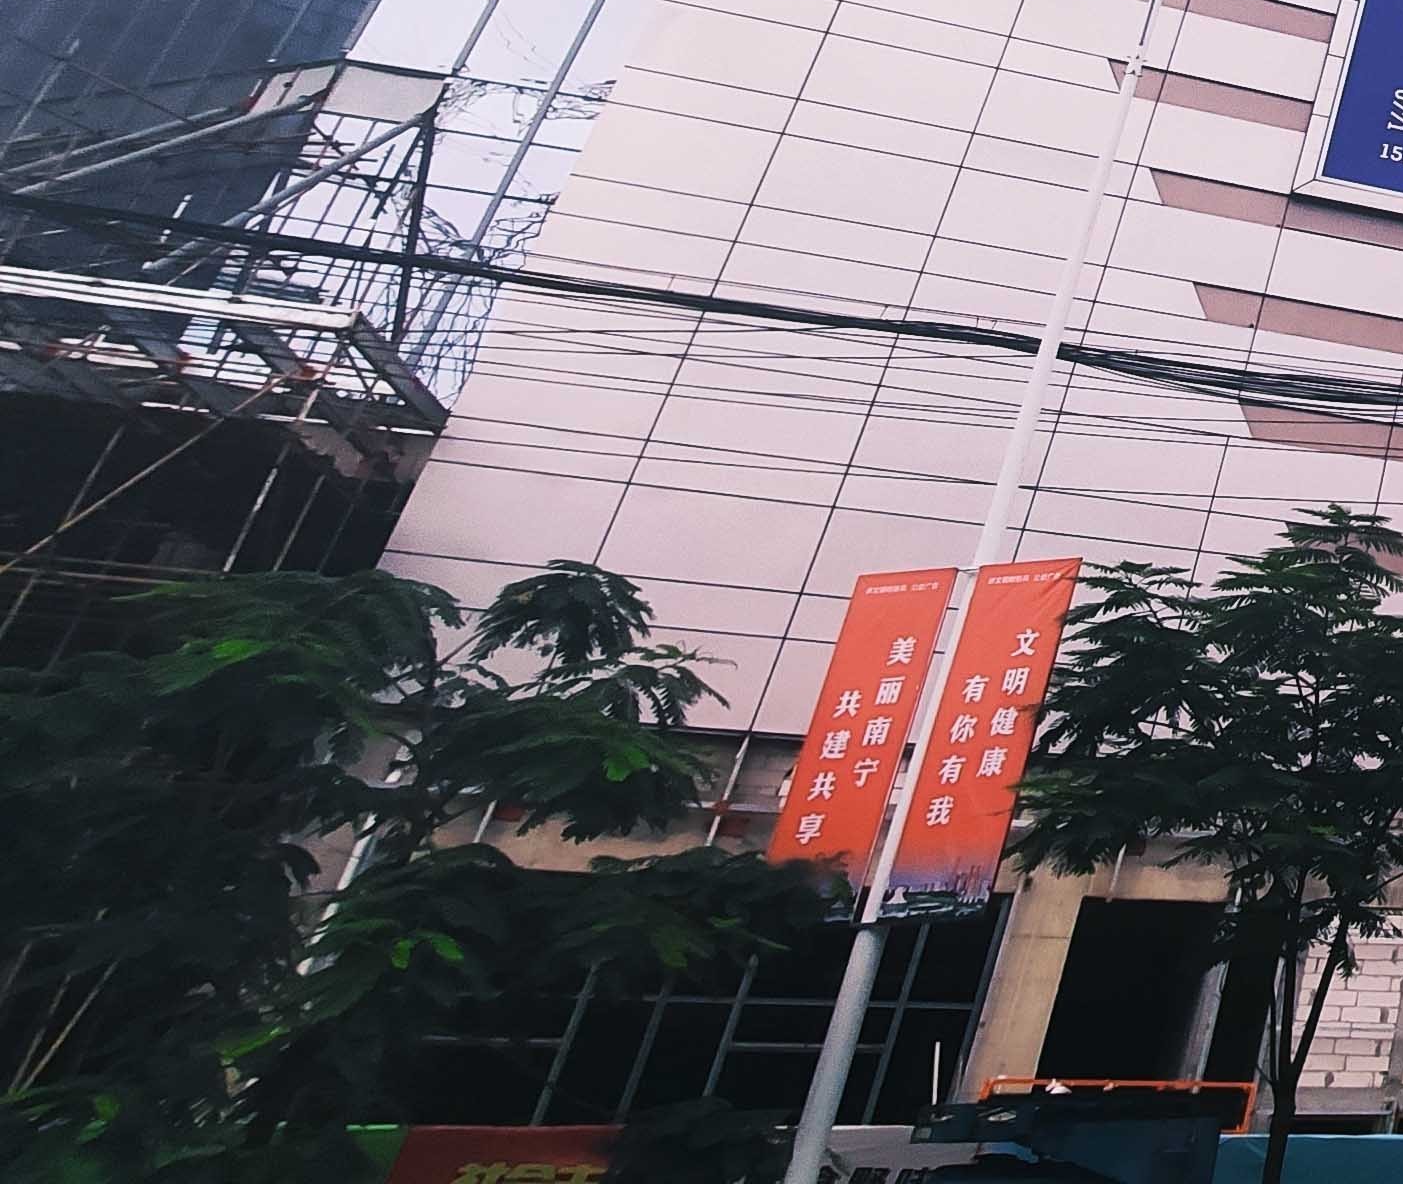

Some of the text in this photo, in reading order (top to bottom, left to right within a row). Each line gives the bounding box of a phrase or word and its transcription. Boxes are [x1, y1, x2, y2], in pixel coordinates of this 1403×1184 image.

[795, 690, 860, 845] 共建共享
[853, 636, 917, 788] 美丽南宁
[926, 675, 990, 827] 有你有我
[976, 628, 1040, 778] 文明健康
